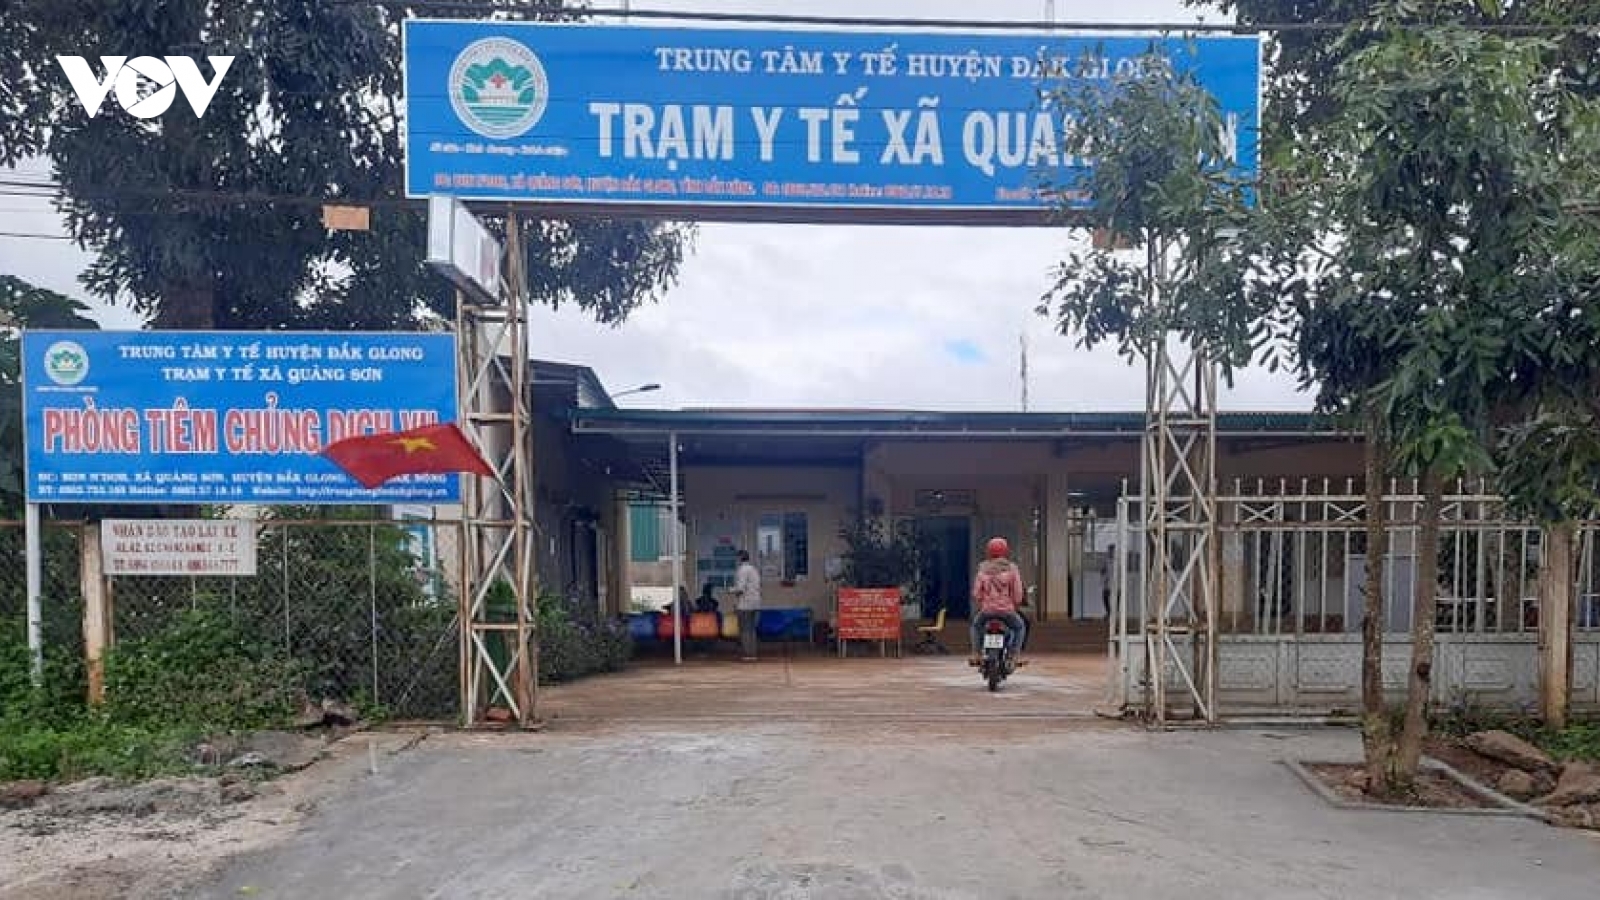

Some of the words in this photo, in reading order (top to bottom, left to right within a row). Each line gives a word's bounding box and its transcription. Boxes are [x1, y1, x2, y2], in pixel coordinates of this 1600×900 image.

[655, 47, 752, 73] TRUNG
[761, 45, 823, 75] TÂM
[832, 52, 849, 76] Y
[859, 43, 897, 77] TẾ
[906, 50, 1001, 82] HUYỆN
[589, 102, 735, 171] TRẠM
[751, 107, 783, 162] Y
[798, 87, 868, 165] TẾ
[880, 96, 943, 166] XÃ
[119, 346, 175, 359] TRUNG
[181, 344, 217, 359] TÂM
[223, 347, 234, 359] Y
[239, 342, 260, 359] TẾ
[266, 345, 322, 361] HUYỆN
[368, 347, 424, 360] GLONG
[162, 368, 210, 382] TRẠM
[216, 369, 226, 381] Y
[231, 363, 253, 381] TẾ
[350, 367, 383, 382] SƠN
[43, 396, 141, 454] PHÒNG
[145, 397, 218, 454] TIÊM
[223, 391, 322, 454] CHỦNG
